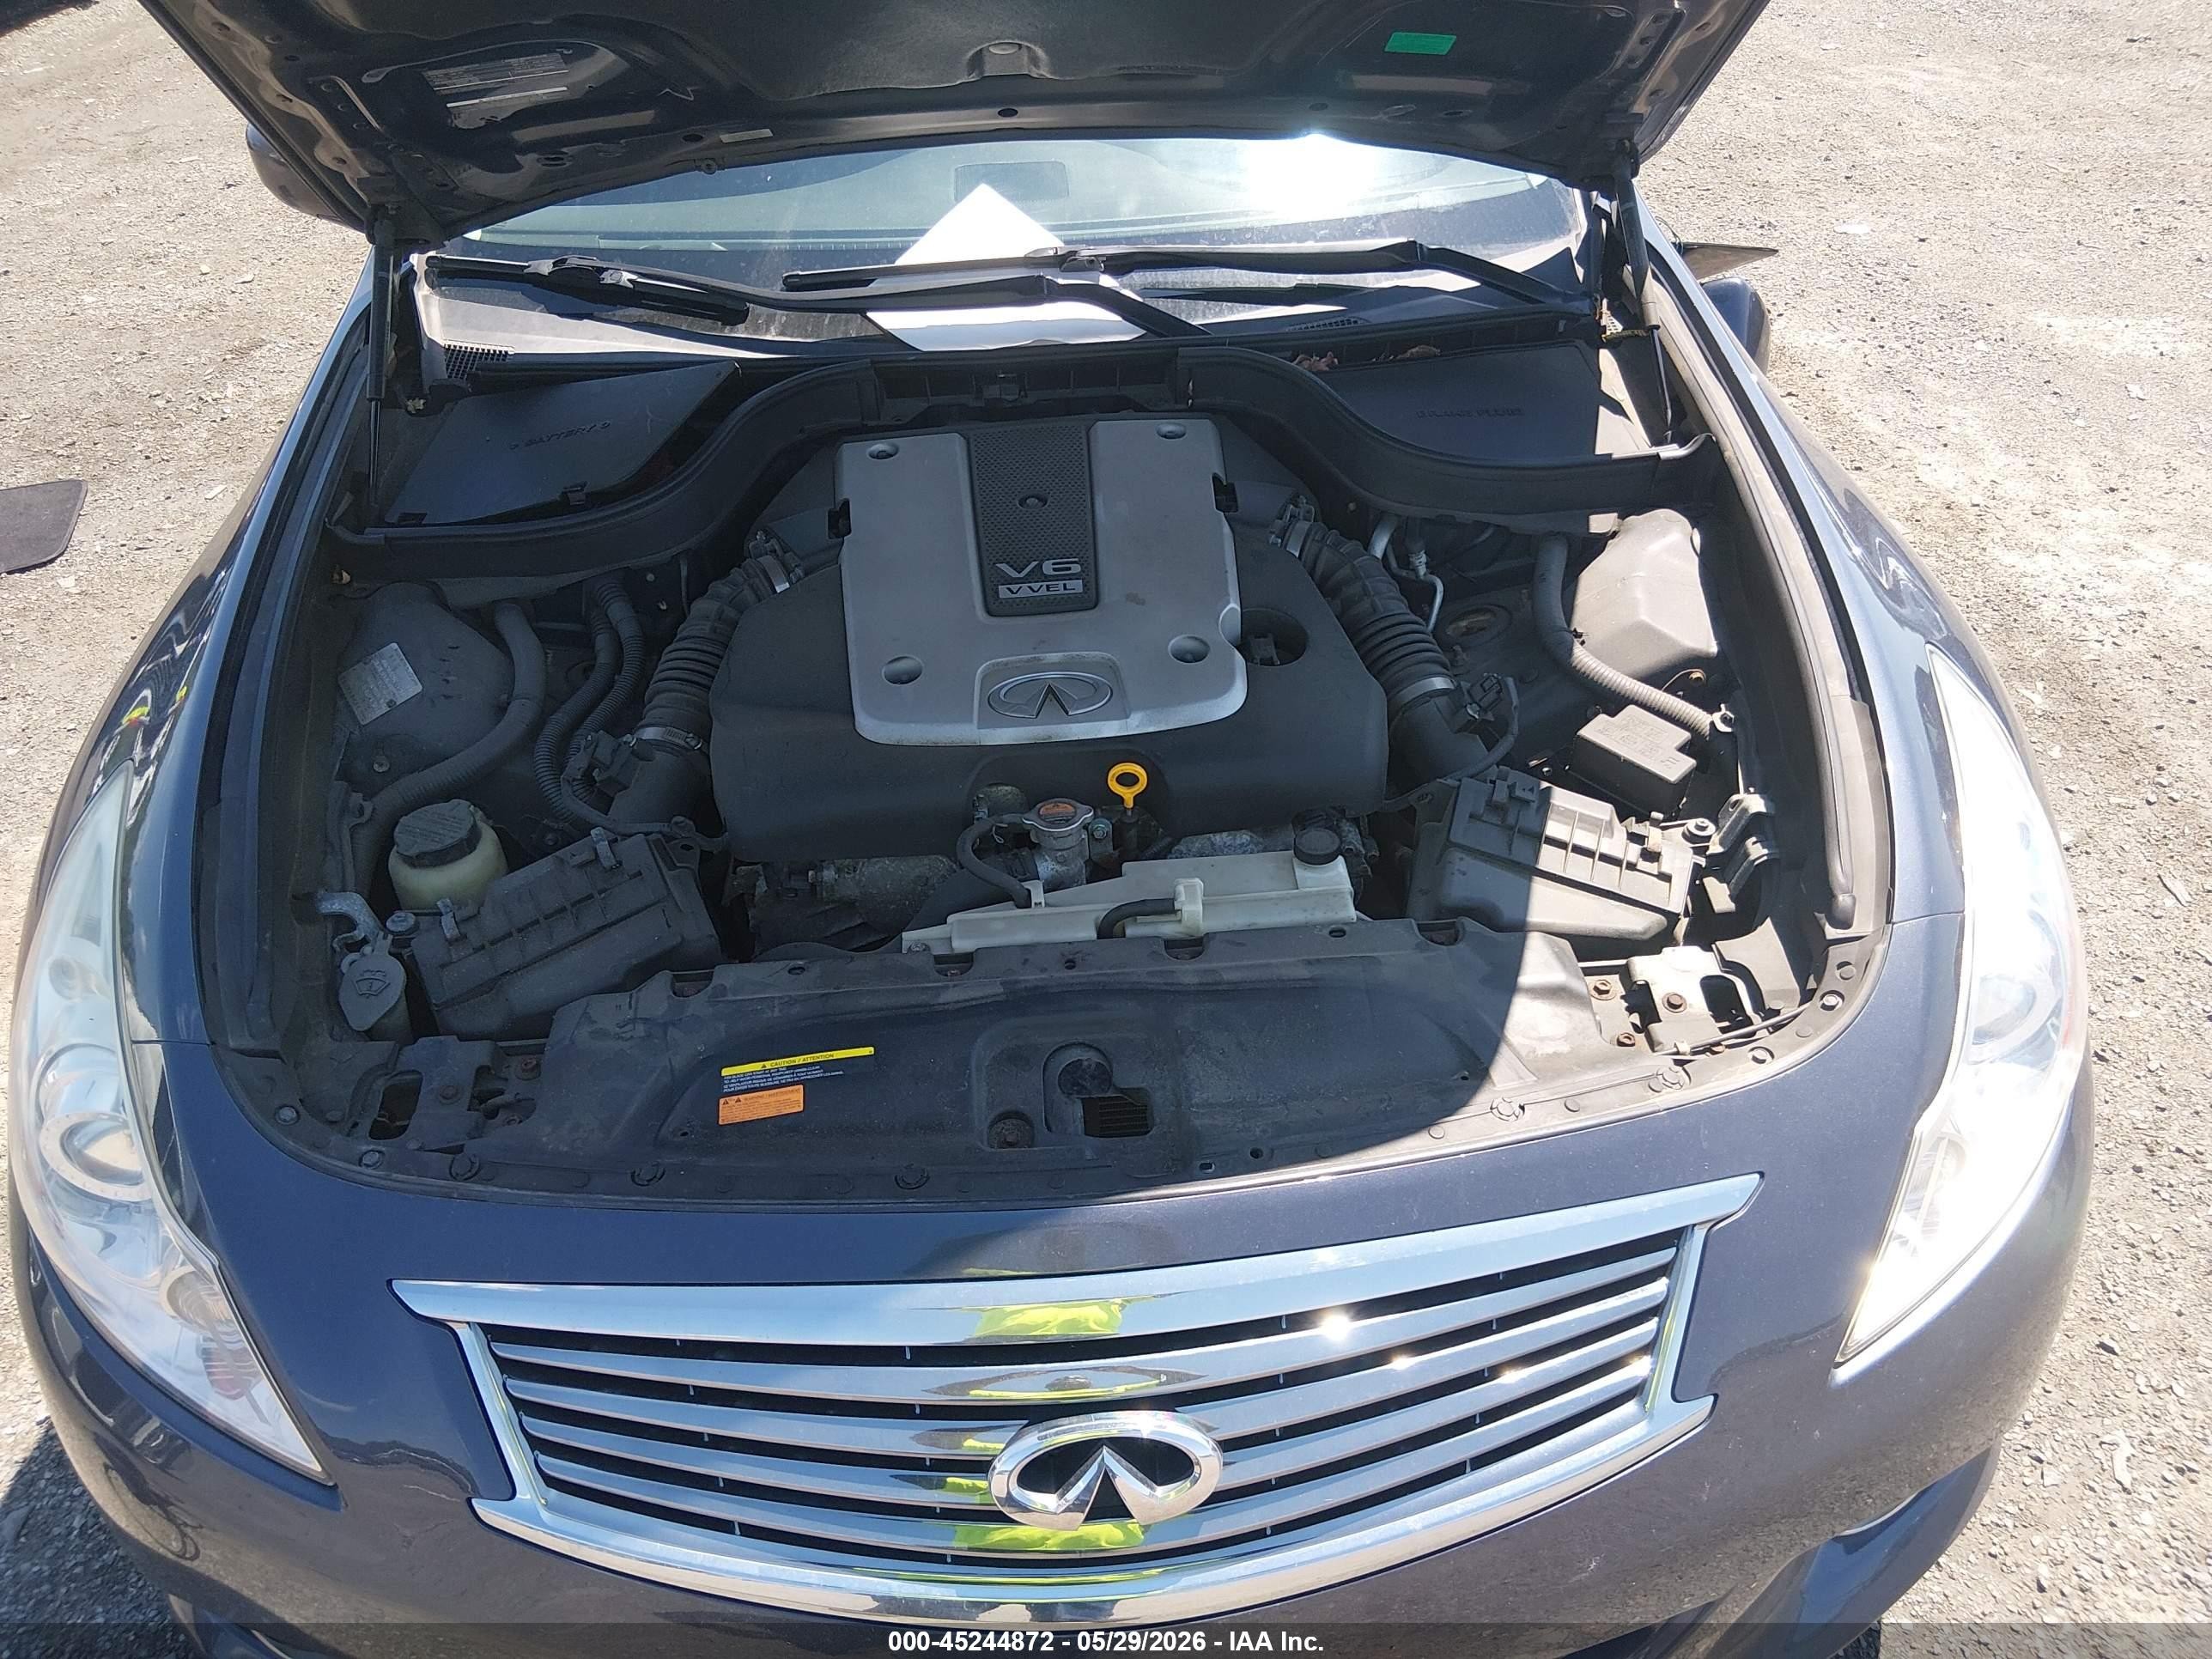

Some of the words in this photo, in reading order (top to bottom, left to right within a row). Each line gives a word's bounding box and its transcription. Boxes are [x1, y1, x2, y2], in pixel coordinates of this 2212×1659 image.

[524, 422, 597, 447] BATTERY
[995, 558, 1082, 578] V6
[1006, 582, 1076, 595] VVEL
[802, 1054, 834, 1062] ATTENTION
